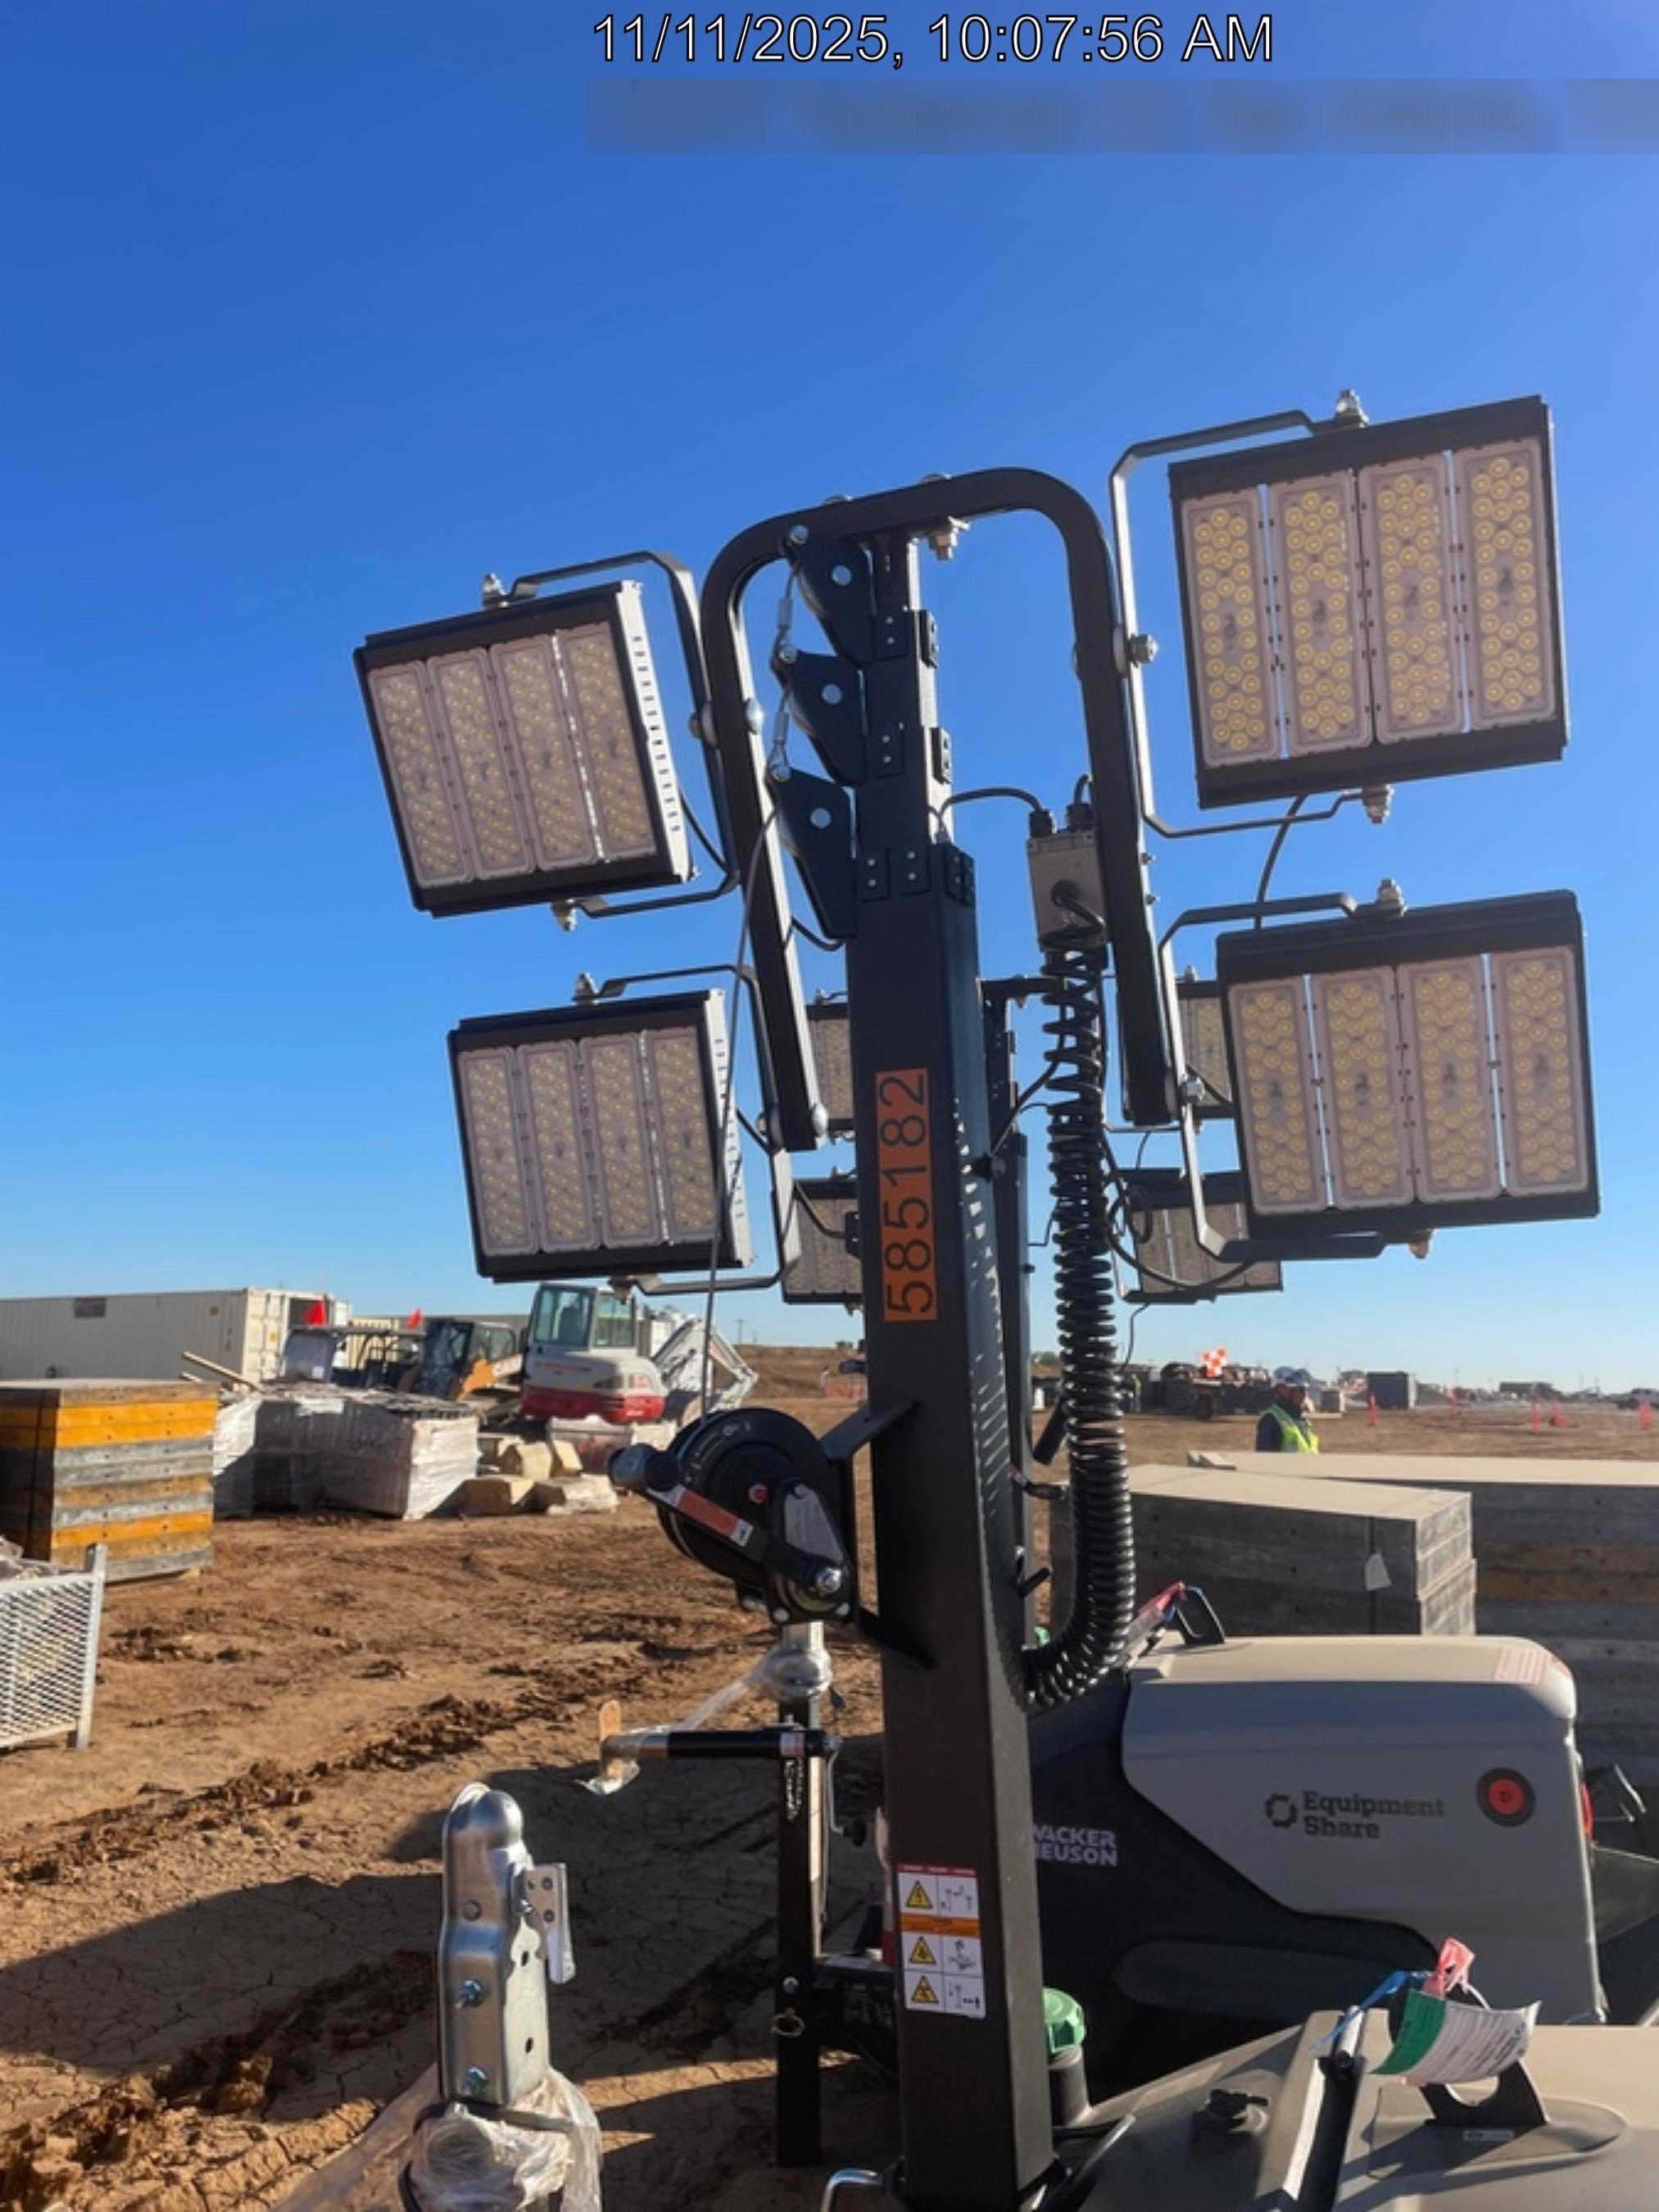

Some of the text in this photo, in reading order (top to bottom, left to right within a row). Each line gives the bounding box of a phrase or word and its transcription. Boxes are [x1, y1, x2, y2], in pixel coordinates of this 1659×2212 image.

[879, 1072, 933, 1313] 585182
[1302, 1790, 1445, 1817] Equipment
[1303, 1815, 1380, 1839] Share
